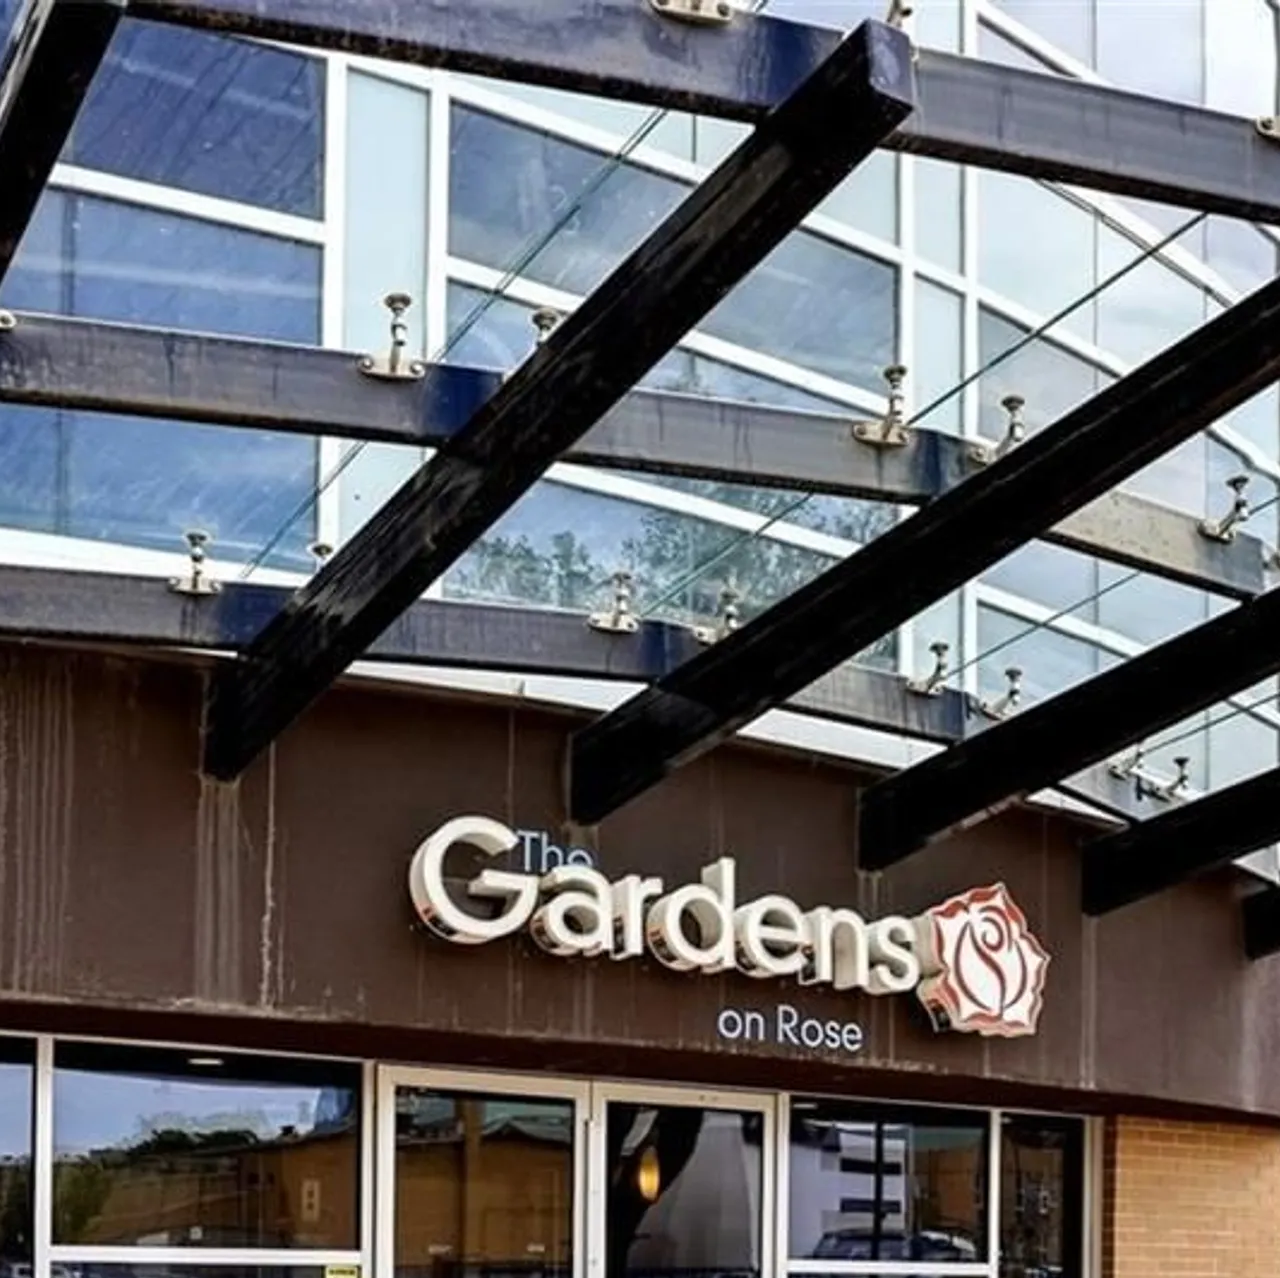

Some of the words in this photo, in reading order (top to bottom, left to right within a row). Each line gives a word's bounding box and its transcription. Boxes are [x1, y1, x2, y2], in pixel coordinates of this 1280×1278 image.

[410, 815, 920, 995] Gardens
[718, 1009, 765, 1041] on
[777, 1004, 863, 1051] Rose
